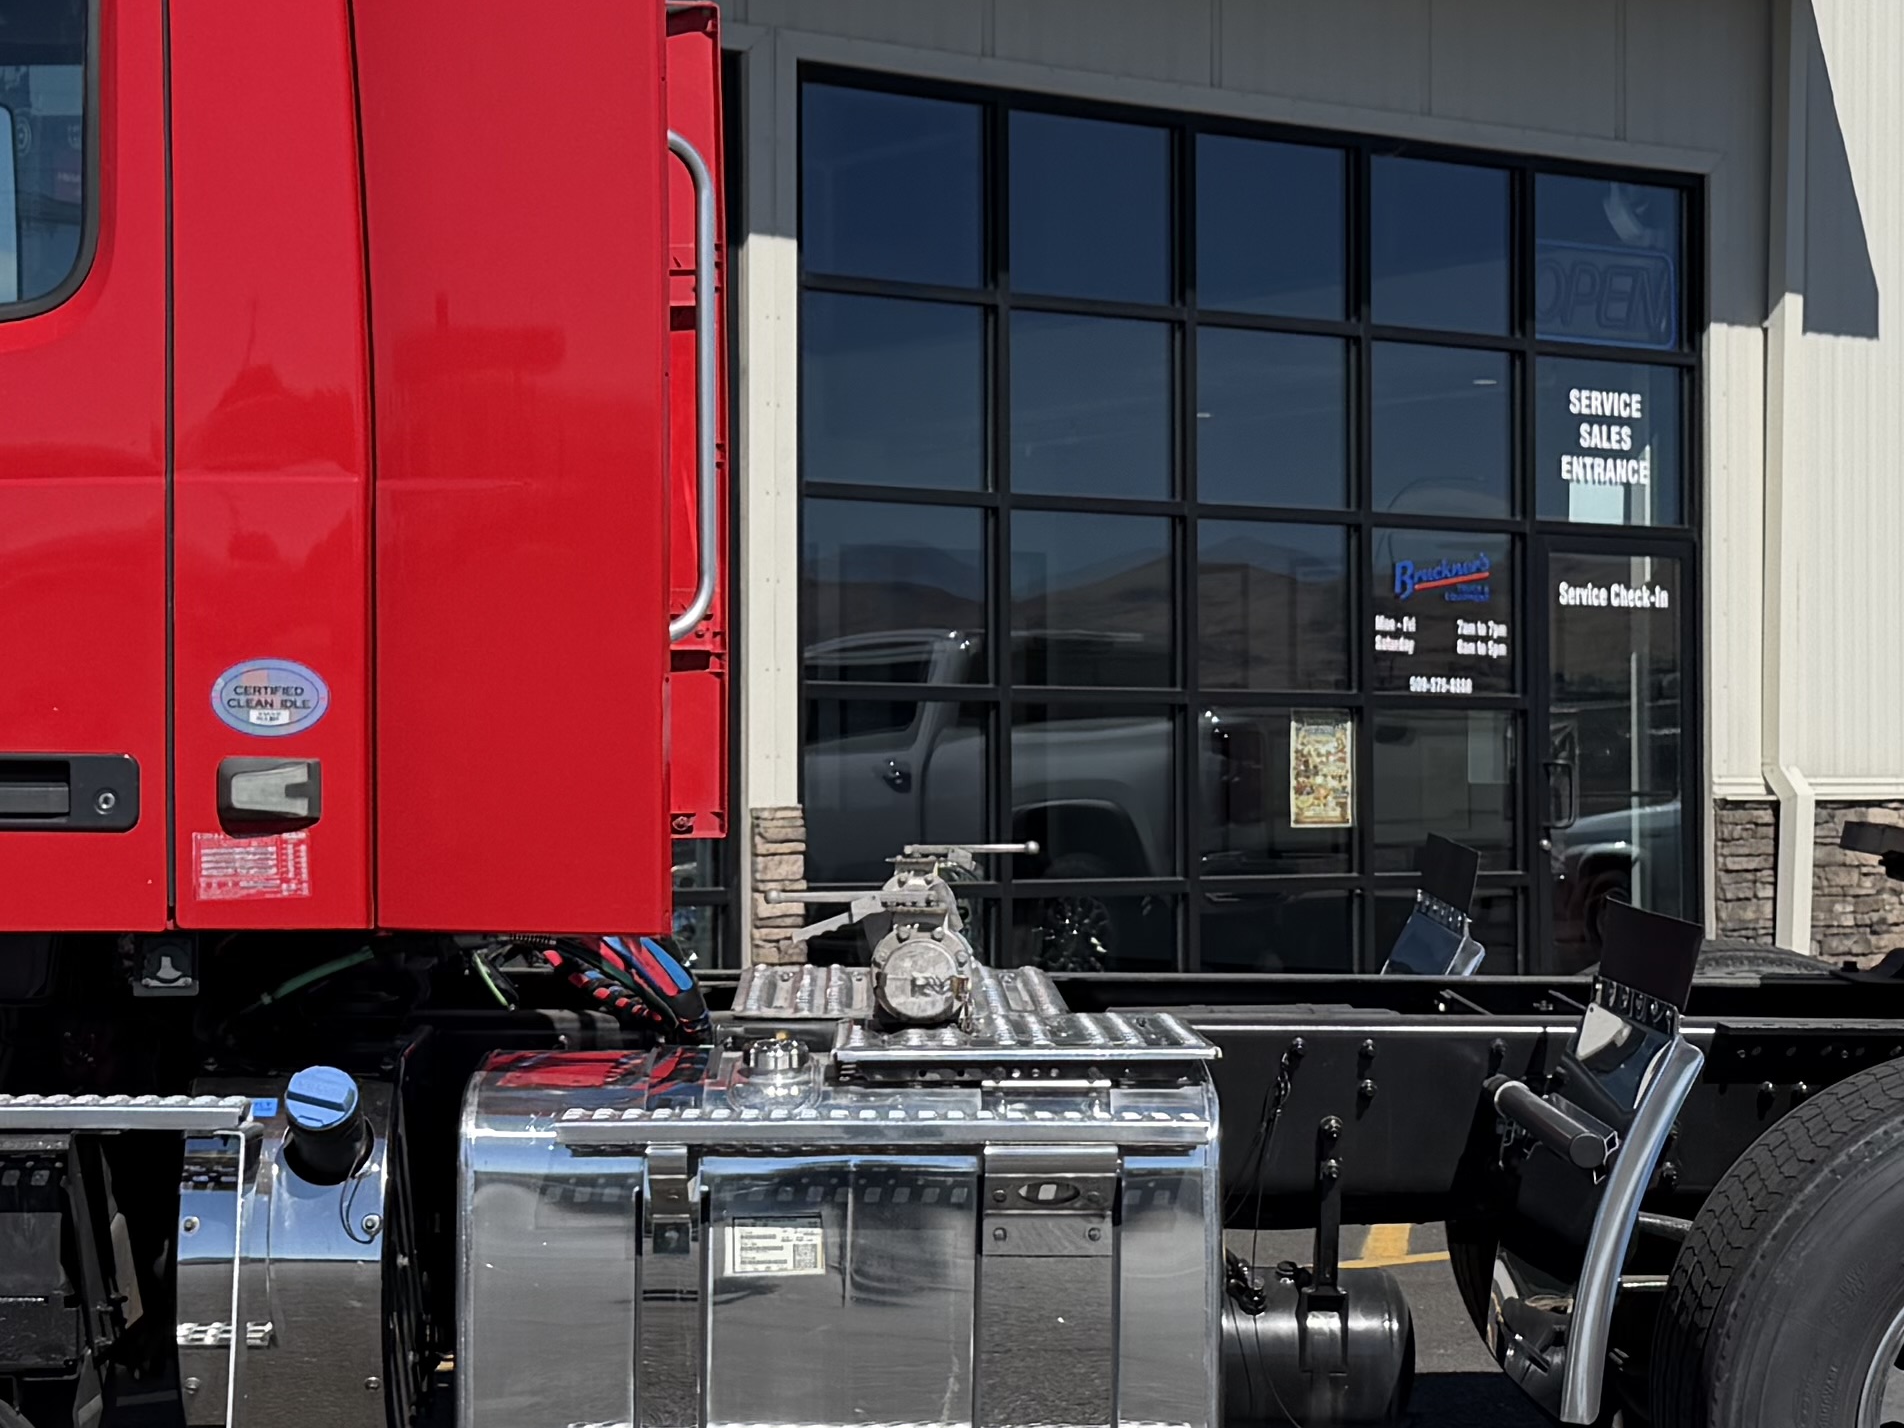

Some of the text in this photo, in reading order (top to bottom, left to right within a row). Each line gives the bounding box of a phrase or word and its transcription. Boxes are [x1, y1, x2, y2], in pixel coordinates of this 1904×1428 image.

[1569, 388, 1642, 418] SERVICE
[1579, 422, 1632, 451] SALES
[1561, 455, 1650, 485] ENTRANCE
[1559, 581, 1669, 608] Service Check-In
[227, 698, 312, 710] CLEAN IDLE
[233, 685, 305, 697] CERTIFIED
